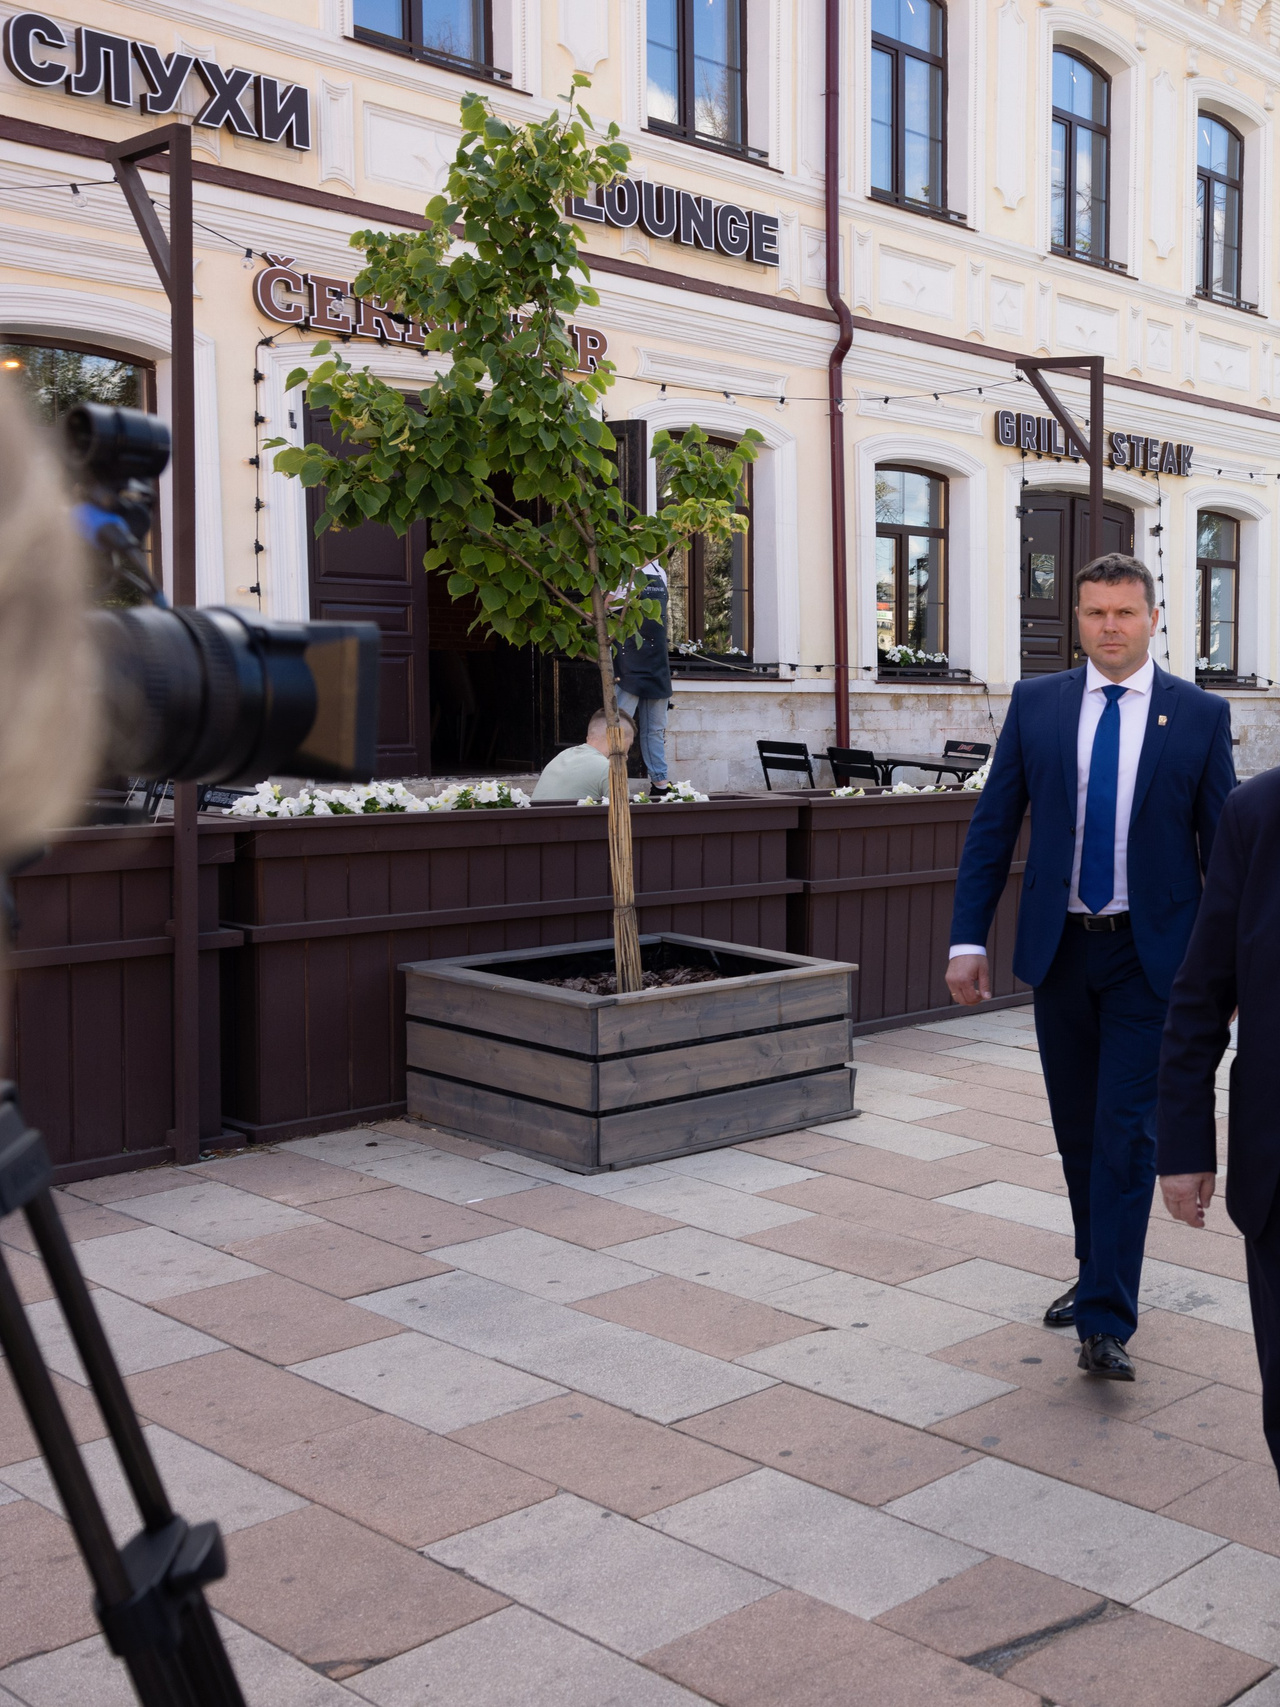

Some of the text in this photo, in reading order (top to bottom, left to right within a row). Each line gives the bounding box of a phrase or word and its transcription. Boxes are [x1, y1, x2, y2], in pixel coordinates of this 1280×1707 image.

[3, 12, 311, 151] СЛУХИ
[566, 174, 780, 267] LOUNGE
[253, 251, 611, 374] ČERR
[1108, 432, 1195, 476] STEAK
